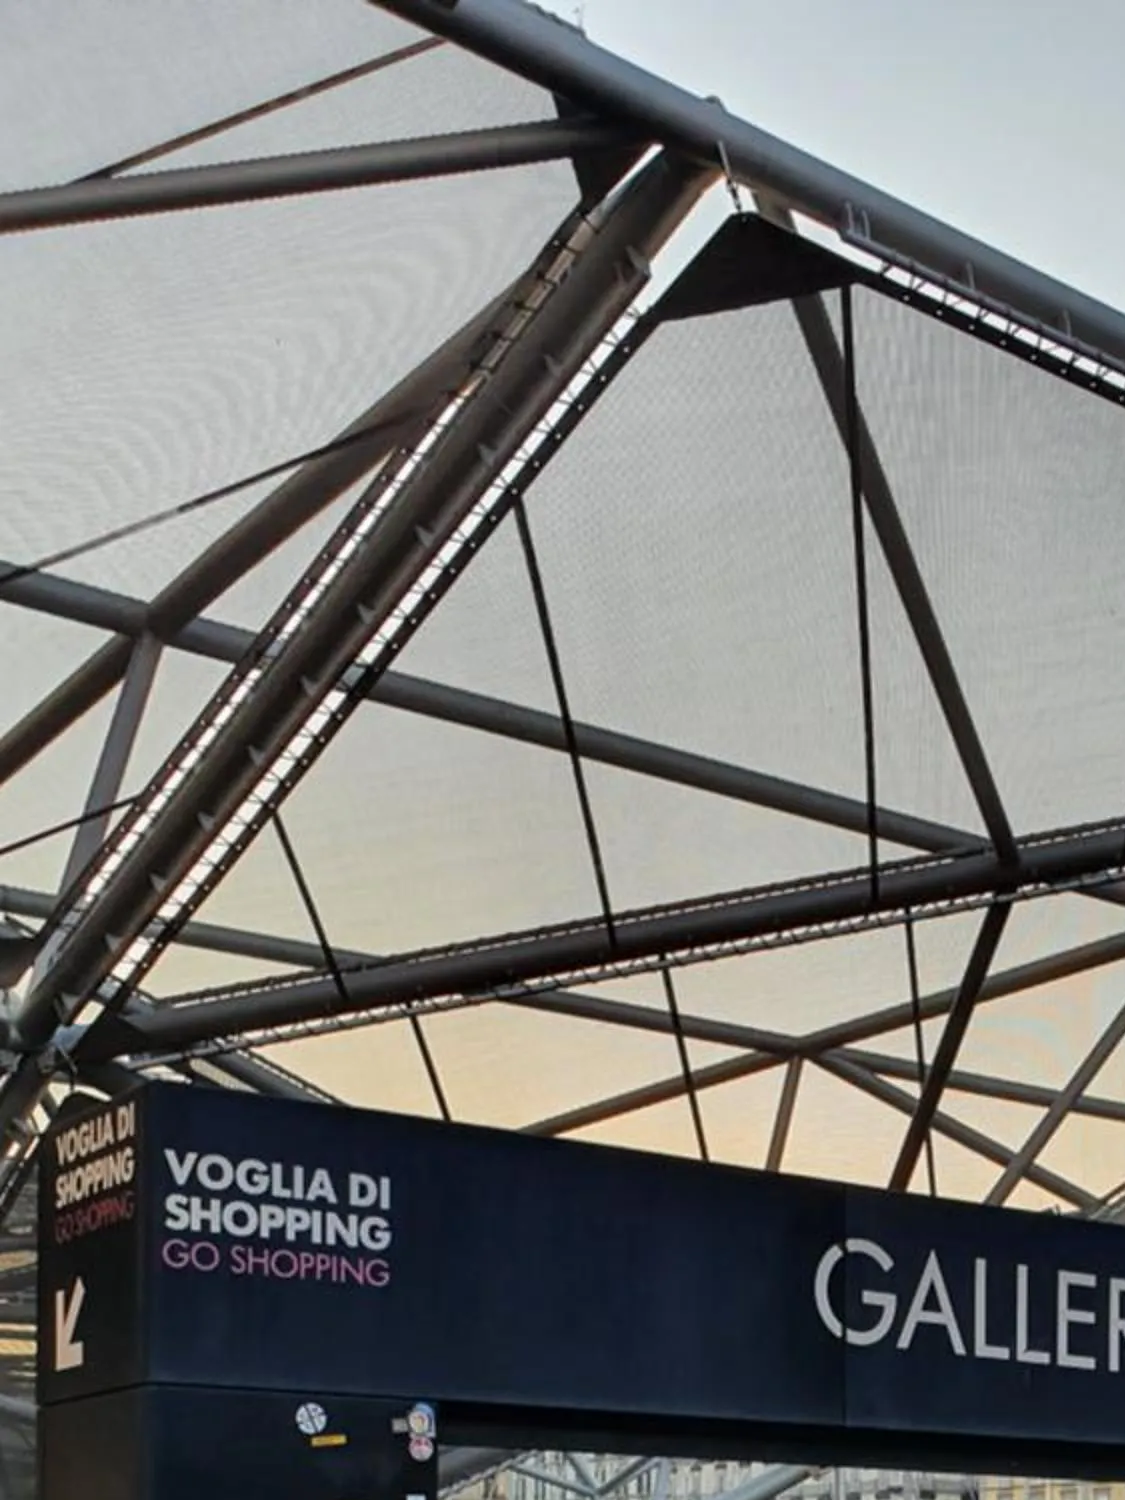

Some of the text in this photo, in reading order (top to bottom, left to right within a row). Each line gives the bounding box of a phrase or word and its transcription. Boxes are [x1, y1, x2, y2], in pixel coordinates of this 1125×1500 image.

[55, 1102, 135, 1166] VOGLIA DI
[55, 1147, 135, 1209] SHOPPING
[164, 1148, 391, 1210] VOGLIA DI
[164, 1193, 392, 1250] SHOPPING
[162, 1239, 391, 1288] GO SHOPPING
